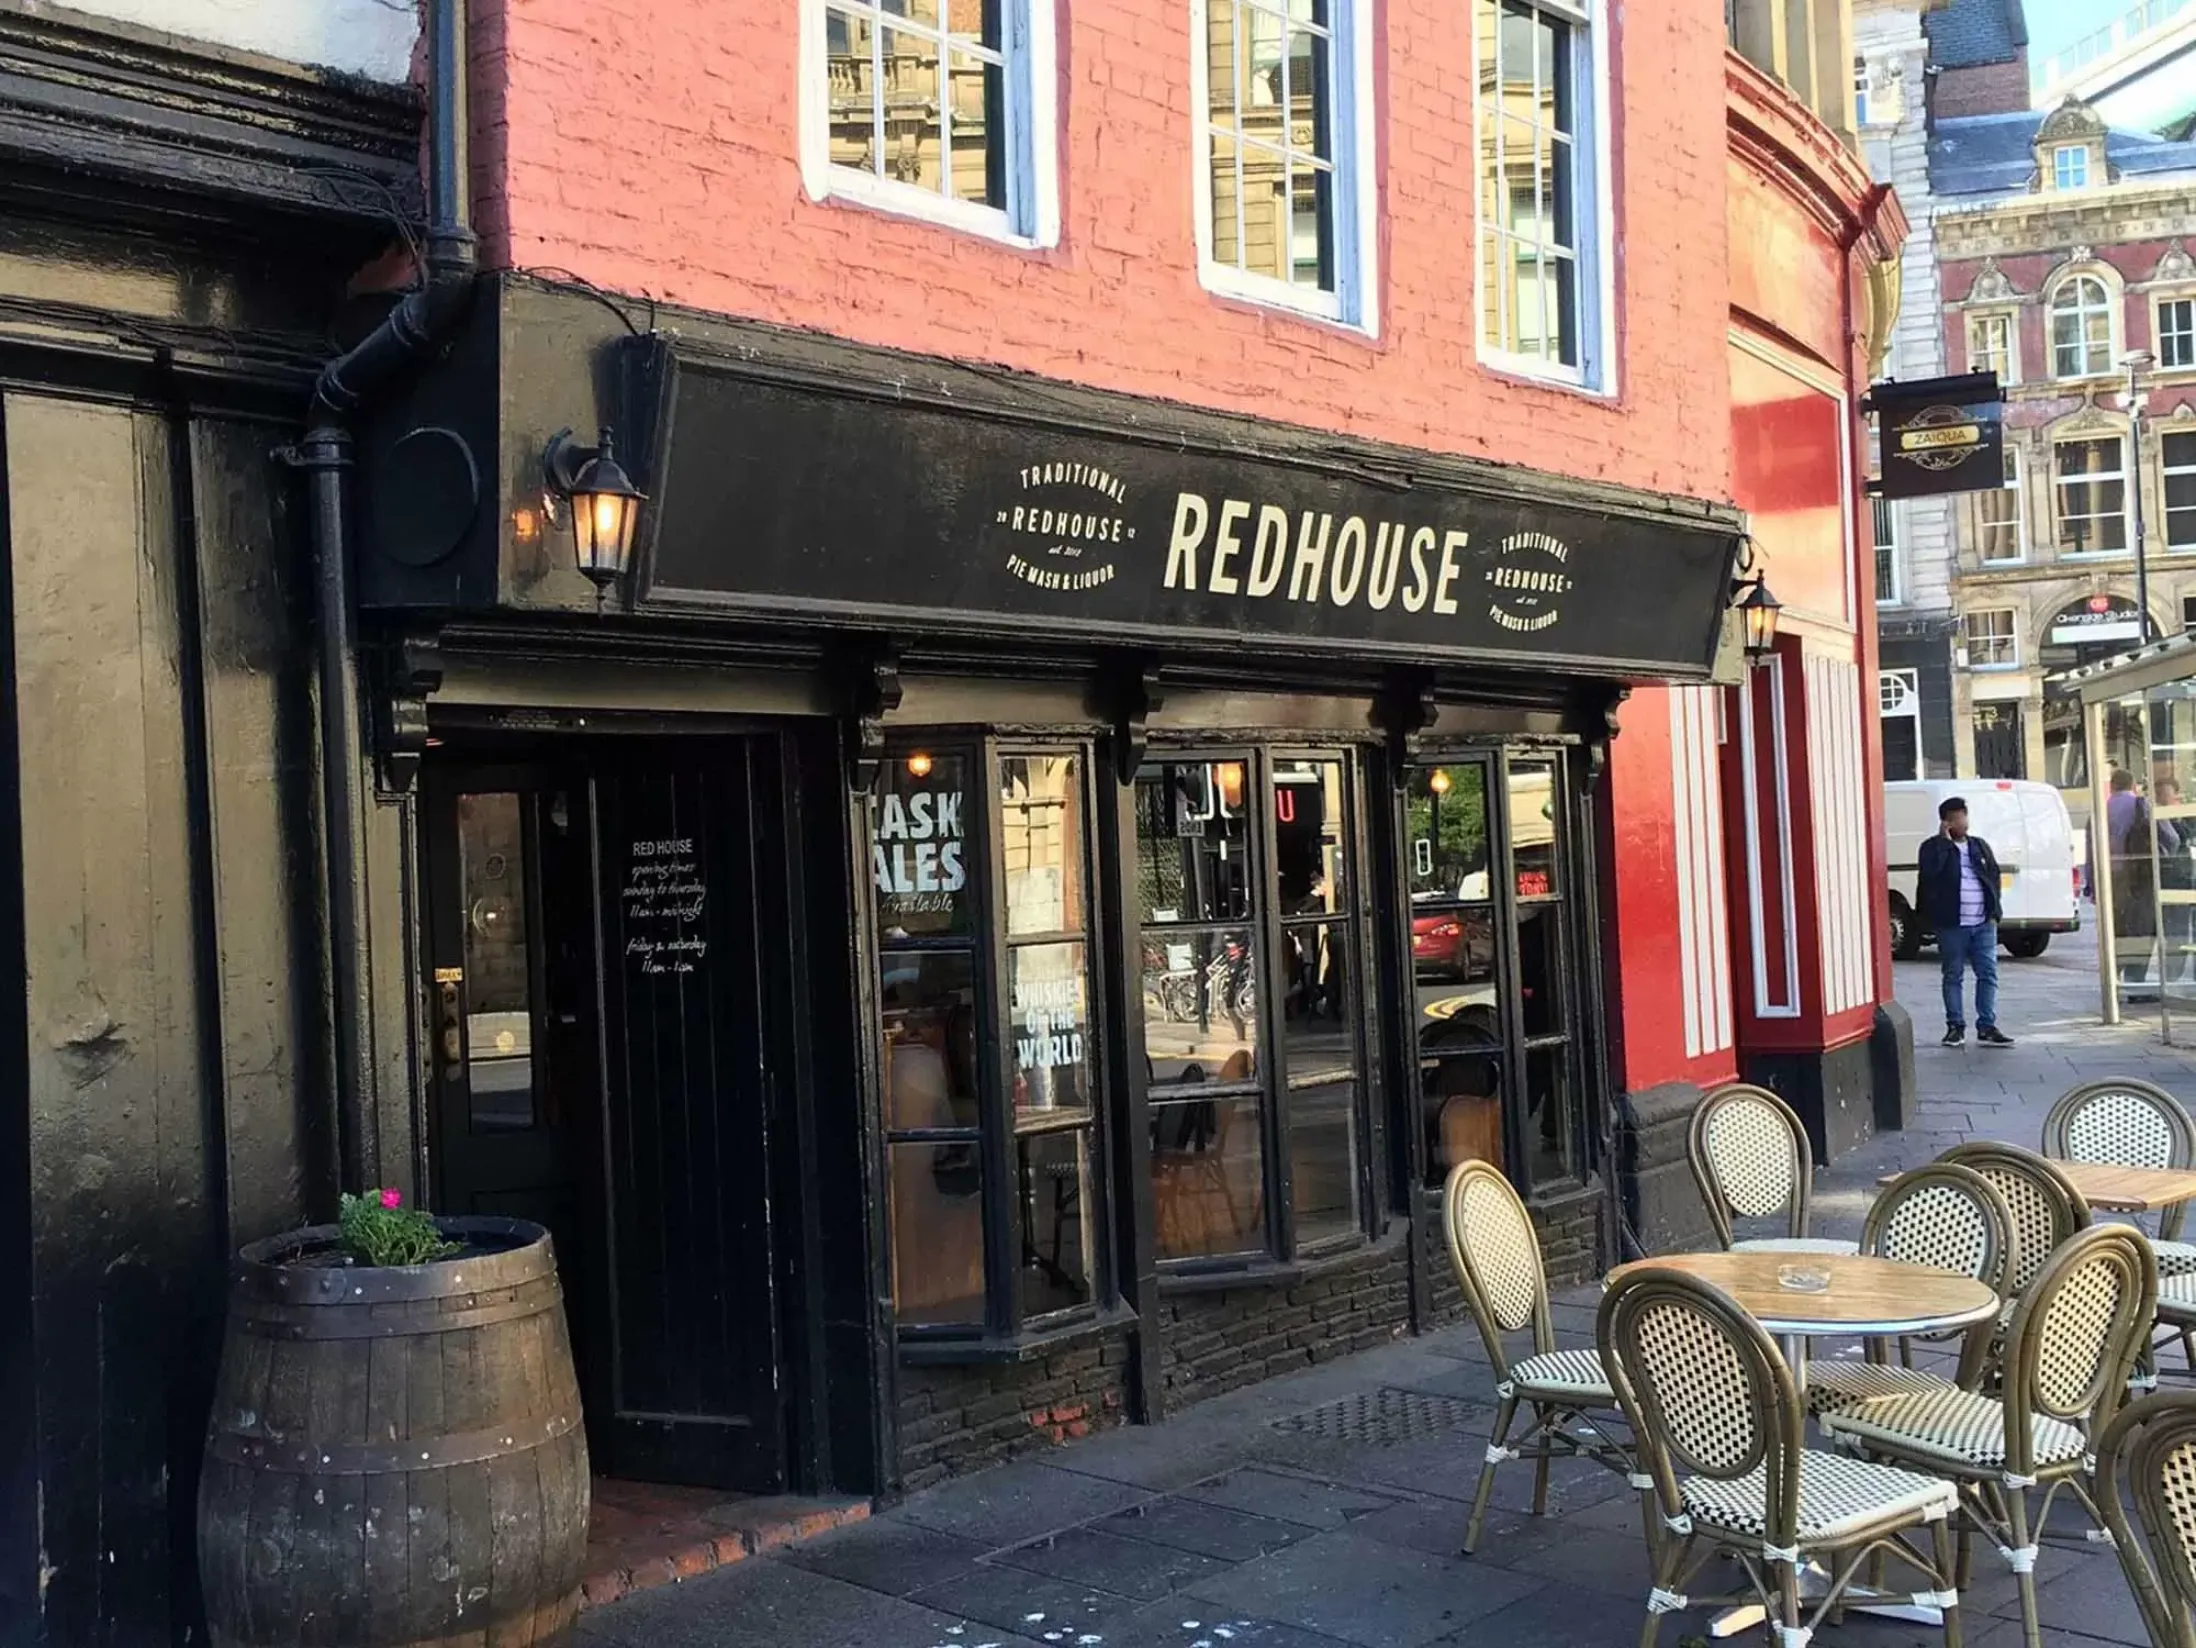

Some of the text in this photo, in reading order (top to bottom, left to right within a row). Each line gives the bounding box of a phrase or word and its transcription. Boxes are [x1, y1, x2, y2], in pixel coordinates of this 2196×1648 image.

[1914, 430, 1967, 444] ZAIQUA
[1020, 462, 1126, 504] TRADITIONAL
[1012, 506, 1122, 542] REDHOUSE
[1164, 493, 1468, 615] REDHOUSE
[1501, 532, 1568, 563] TRADITIONAL
[1006, 554, 1115, 590] PIE MASH & LIQUOR
[1494, 567, 1564, 593] REDHOUSE
[632, 838, 693, 856] RED HOUSE
[873, 841, 966, 893] ALES
[1018, 1033, 1082, 1069] WORLD
